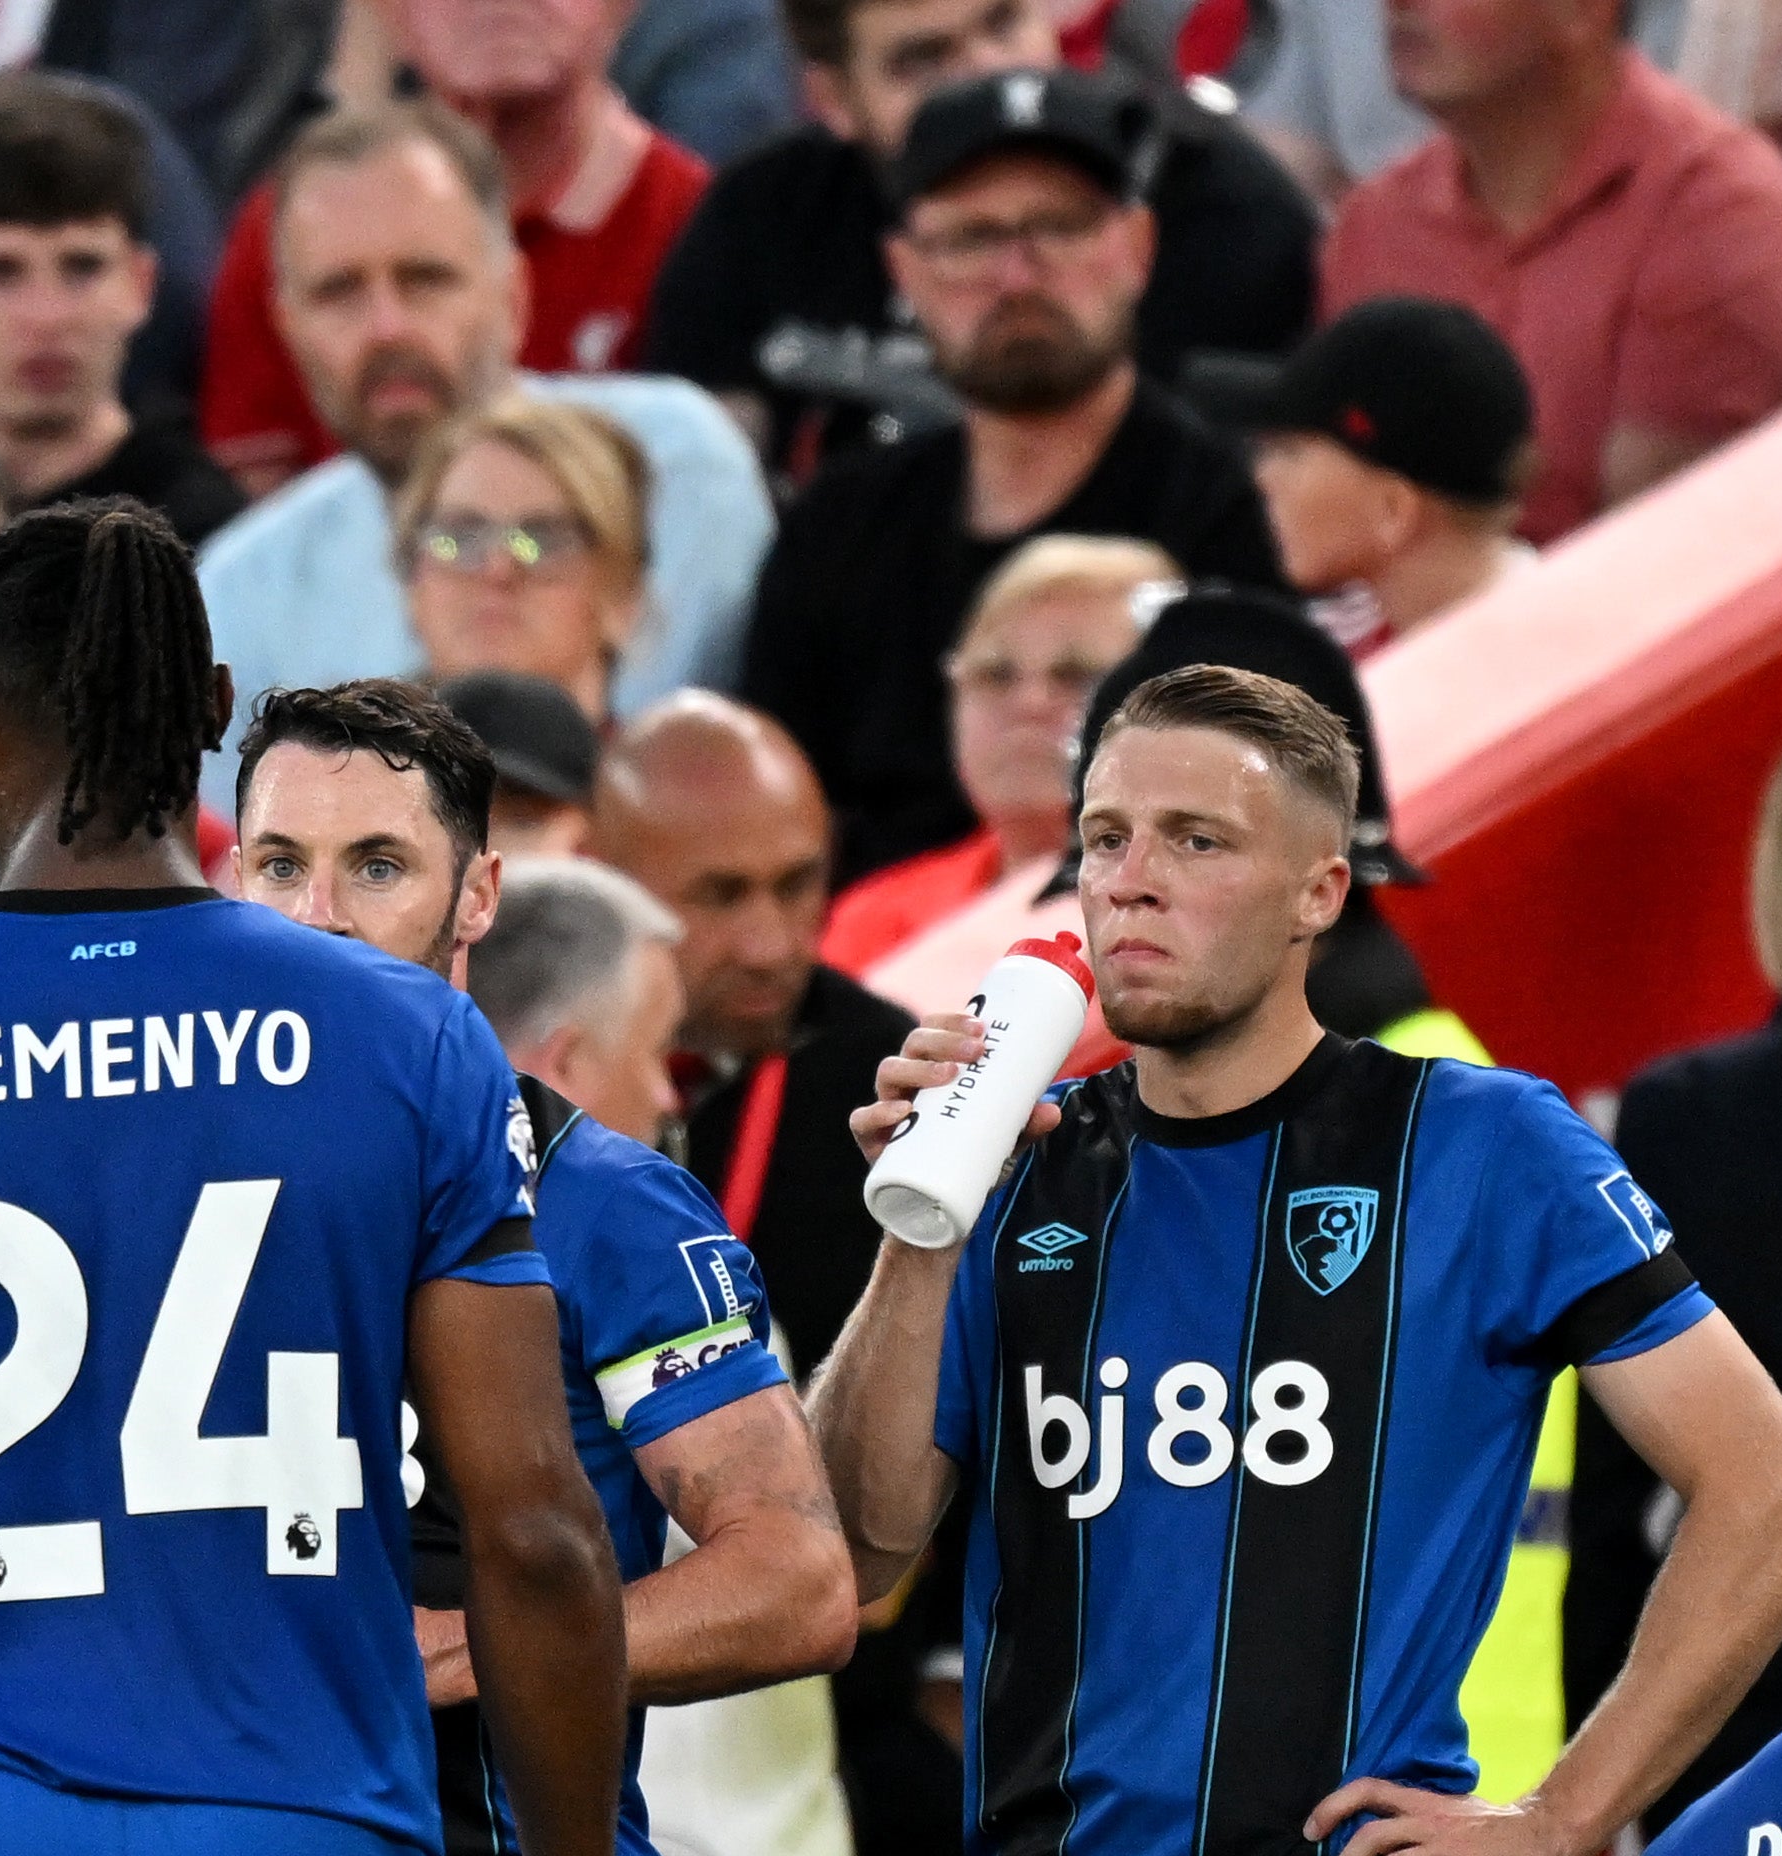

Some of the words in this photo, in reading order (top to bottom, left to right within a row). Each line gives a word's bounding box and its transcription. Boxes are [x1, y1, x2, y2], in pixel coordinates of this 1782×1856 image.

[69, 940, 137, 961] AFCB
[939, 1019, 1010, 1119] HYDRATE
[1018, 1256, 1075, 1273] umbro
[1024, 1356, 1334, 1520] bj88
